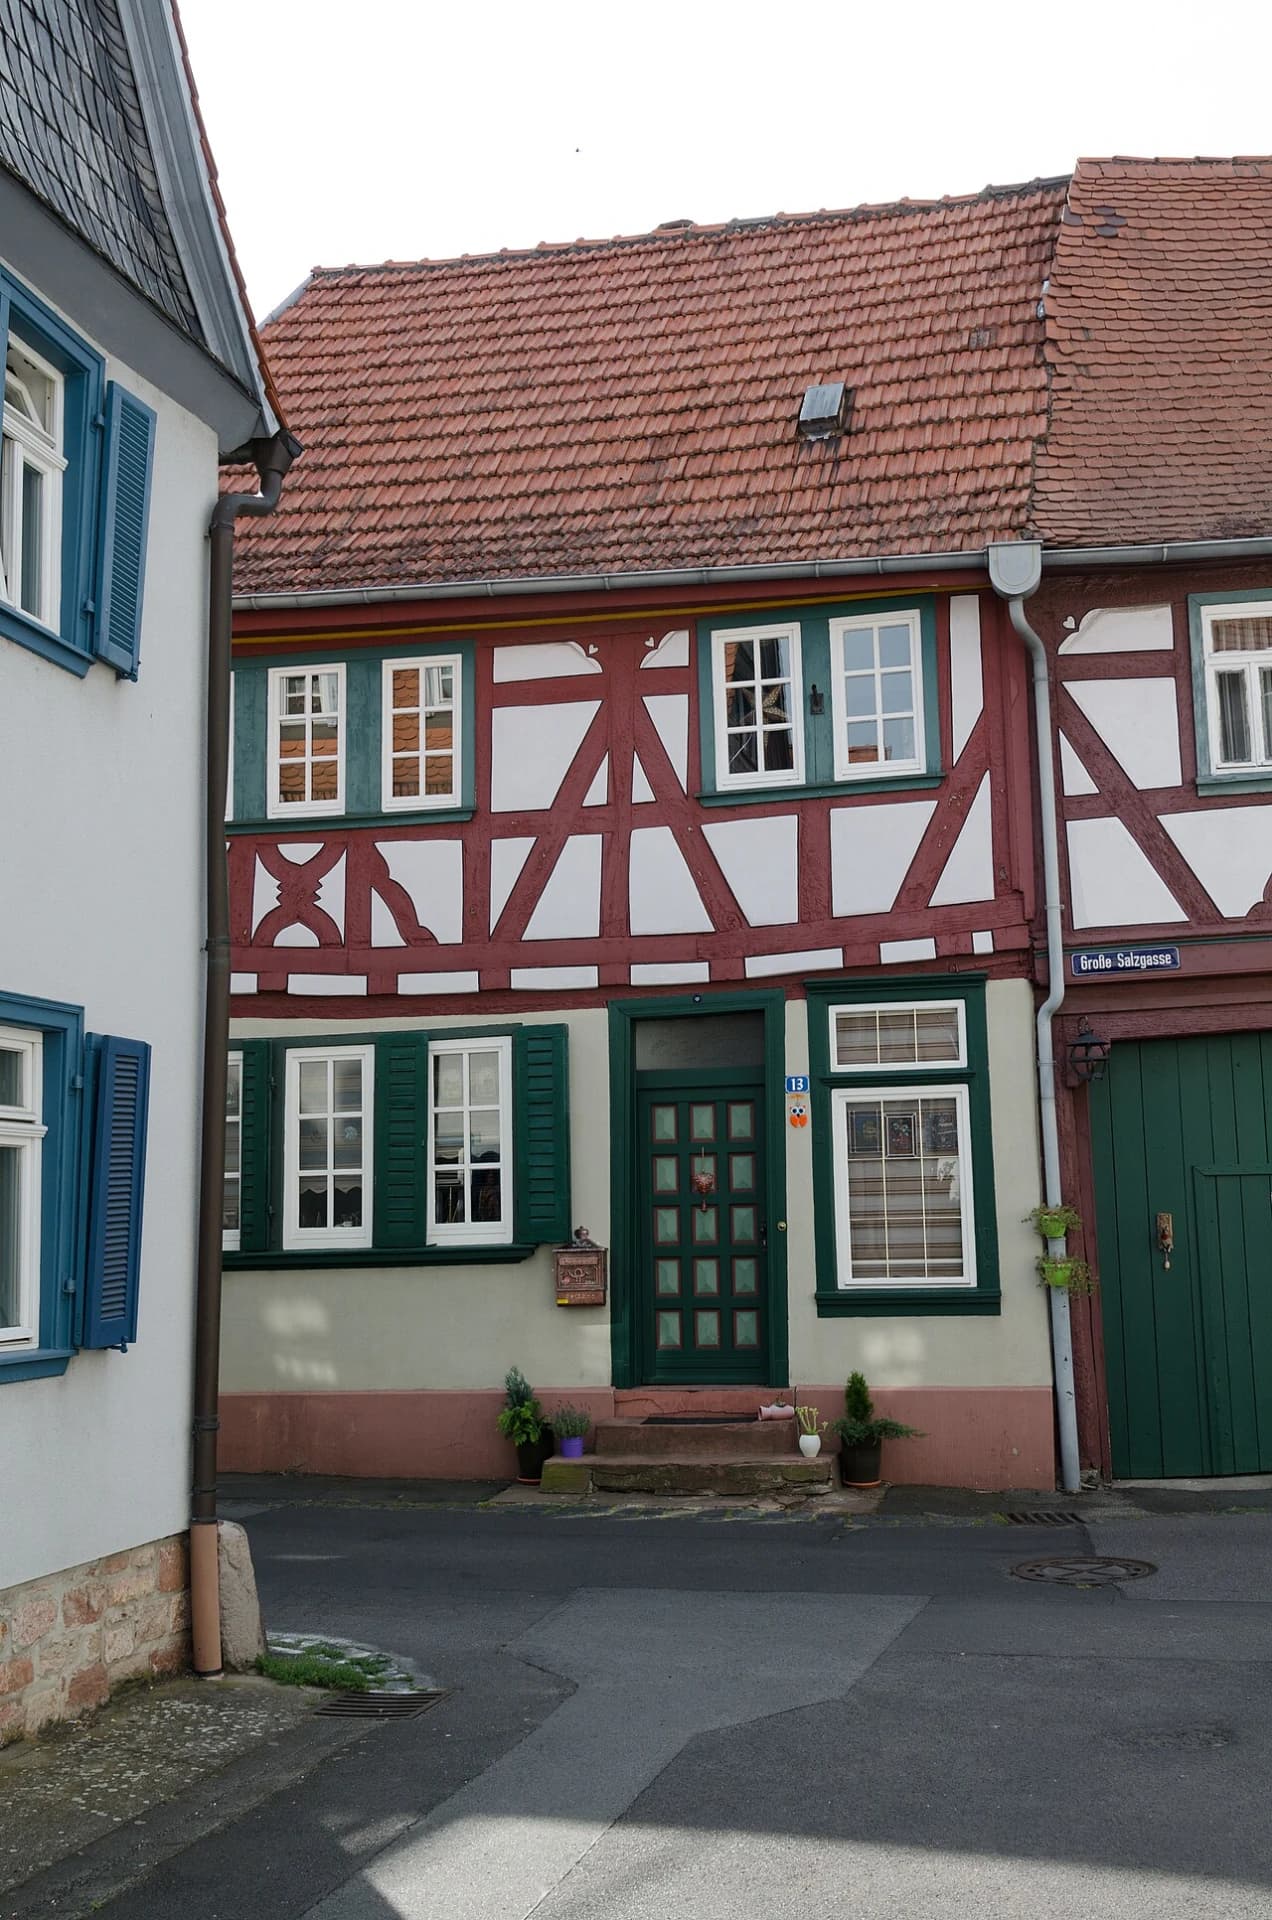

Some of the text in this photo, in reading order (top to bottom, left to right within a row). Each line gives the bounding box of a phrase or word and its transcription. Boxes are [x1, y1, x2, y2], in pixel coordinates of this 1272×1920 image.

[1081, 952, 1172, 970] Große Salzgasse
[791, 1078, 804, 1091] 13
